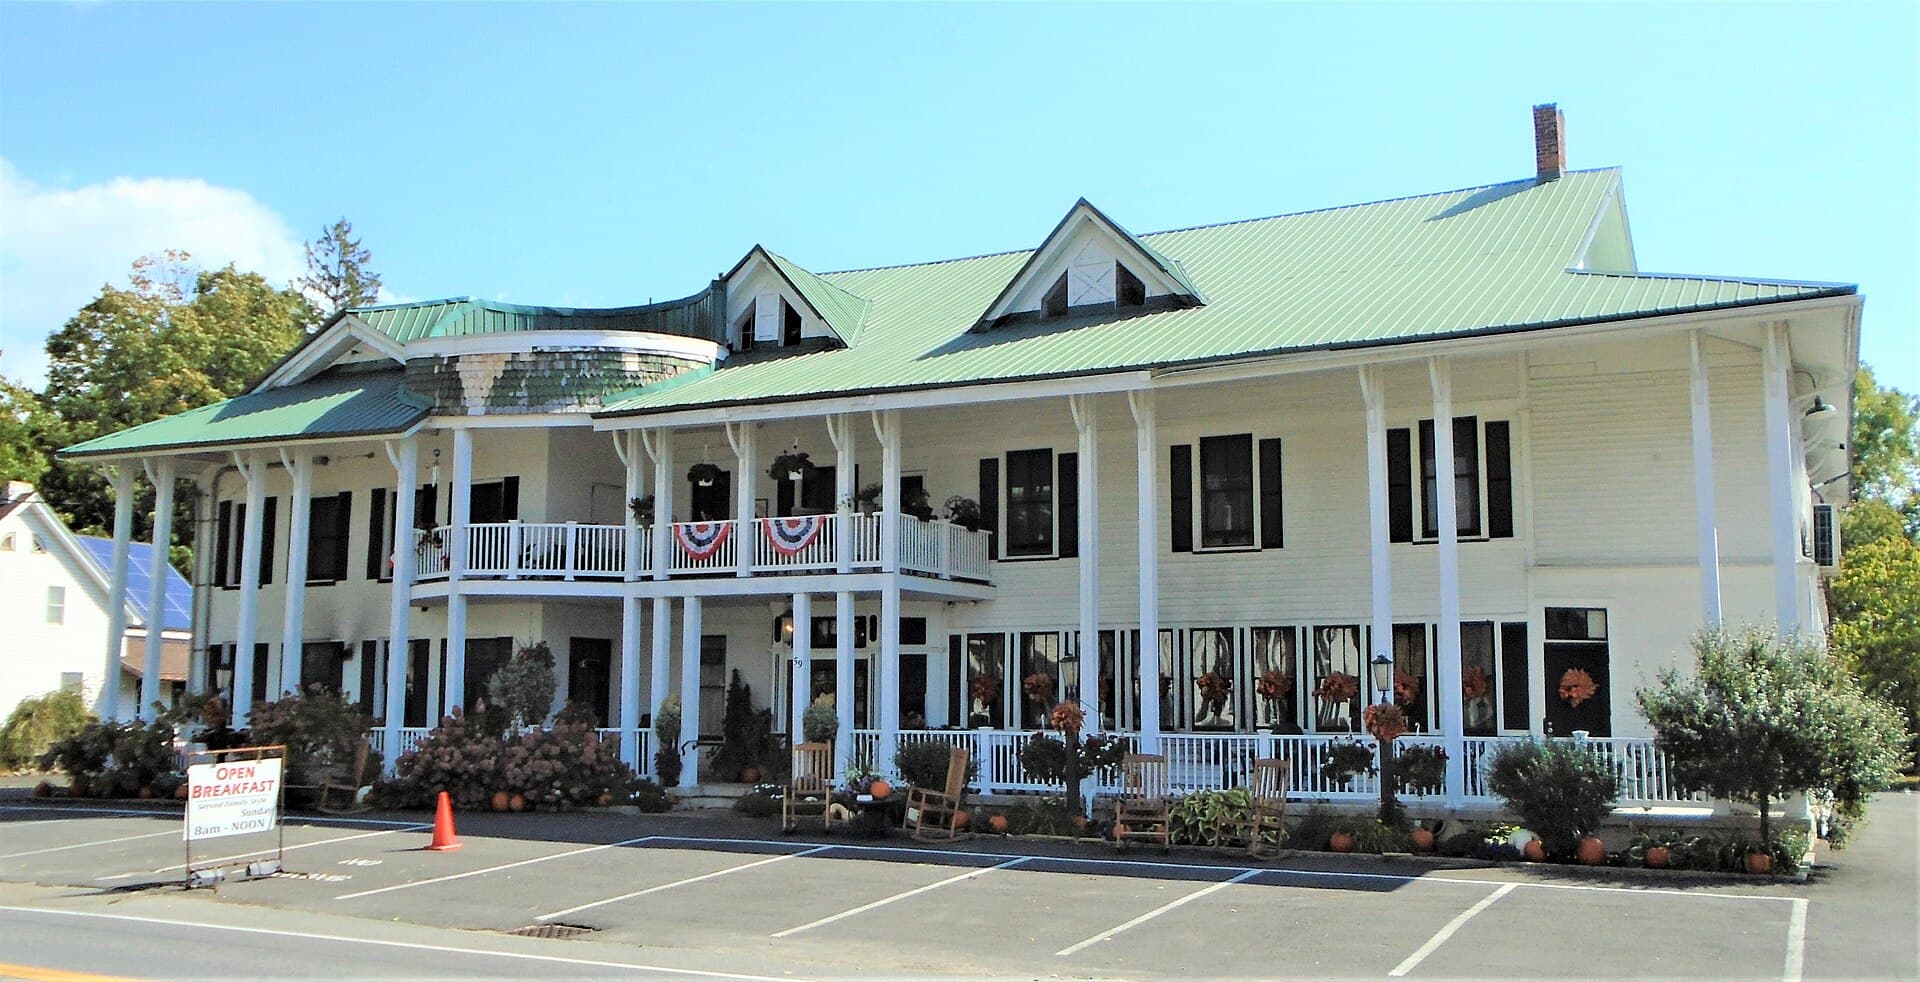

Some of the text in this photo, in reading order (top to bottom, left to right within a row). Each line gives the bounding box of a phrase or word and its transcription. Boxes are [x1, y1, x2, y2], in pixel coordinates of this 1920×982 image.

[216, 768, 255, 780] OPEN
[192, 780, 274, 798] BREAKFAST
[194, 825, 221, 836] 8am
[231, 819, 265, 831] NOON
